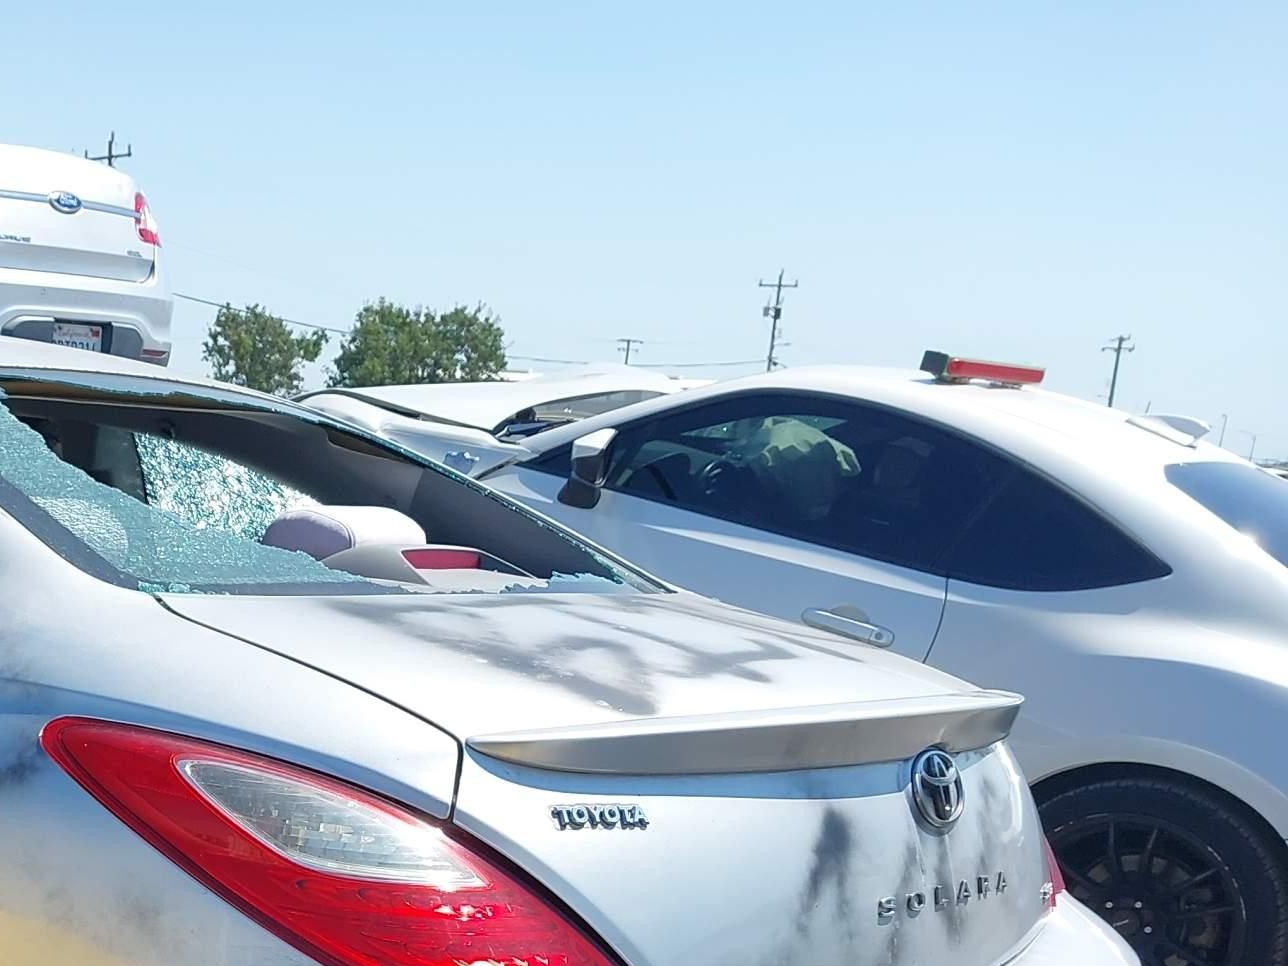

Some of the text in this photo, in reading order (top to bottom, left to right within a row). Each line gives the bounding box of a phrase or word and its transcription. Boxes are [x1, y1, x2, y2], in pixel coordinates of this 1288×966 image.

[59, 192, 79, 207] Ford
[550, 804, 651, 831] TOYOTA
[877, 871, 1010, 920] SOLARA
